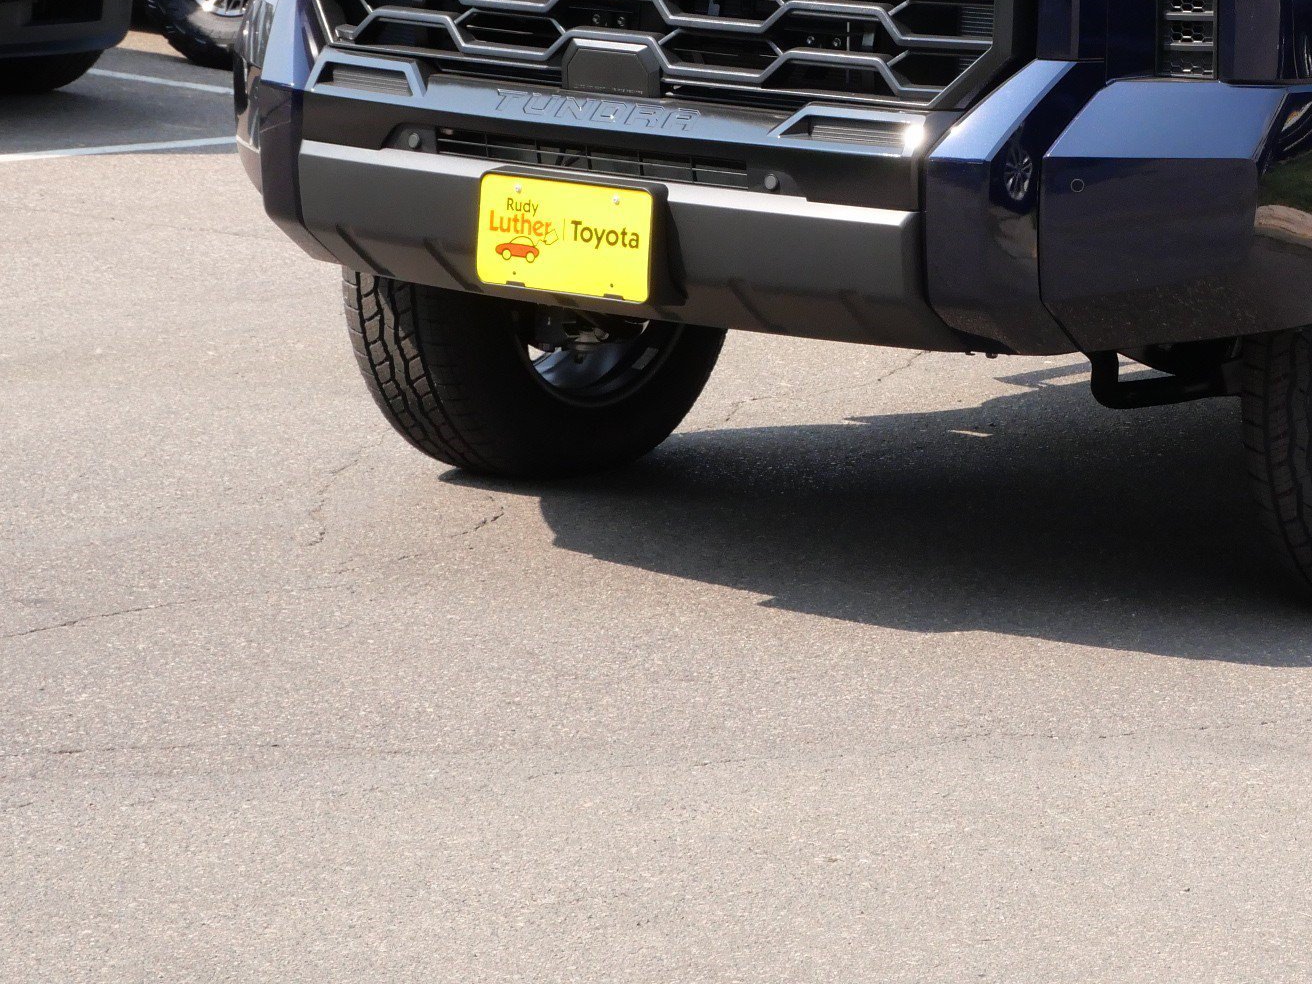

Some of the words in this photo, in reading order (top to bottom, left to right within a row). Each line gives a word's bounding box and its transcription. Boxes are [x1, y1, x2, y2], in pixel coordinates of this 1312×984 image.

[495, 88, 701, 132] TUNDRA
[506, 197, 539, 217] Rudy
[489, 210, 552, 237] Luther
[570, 219, 641, 250] Toyota
